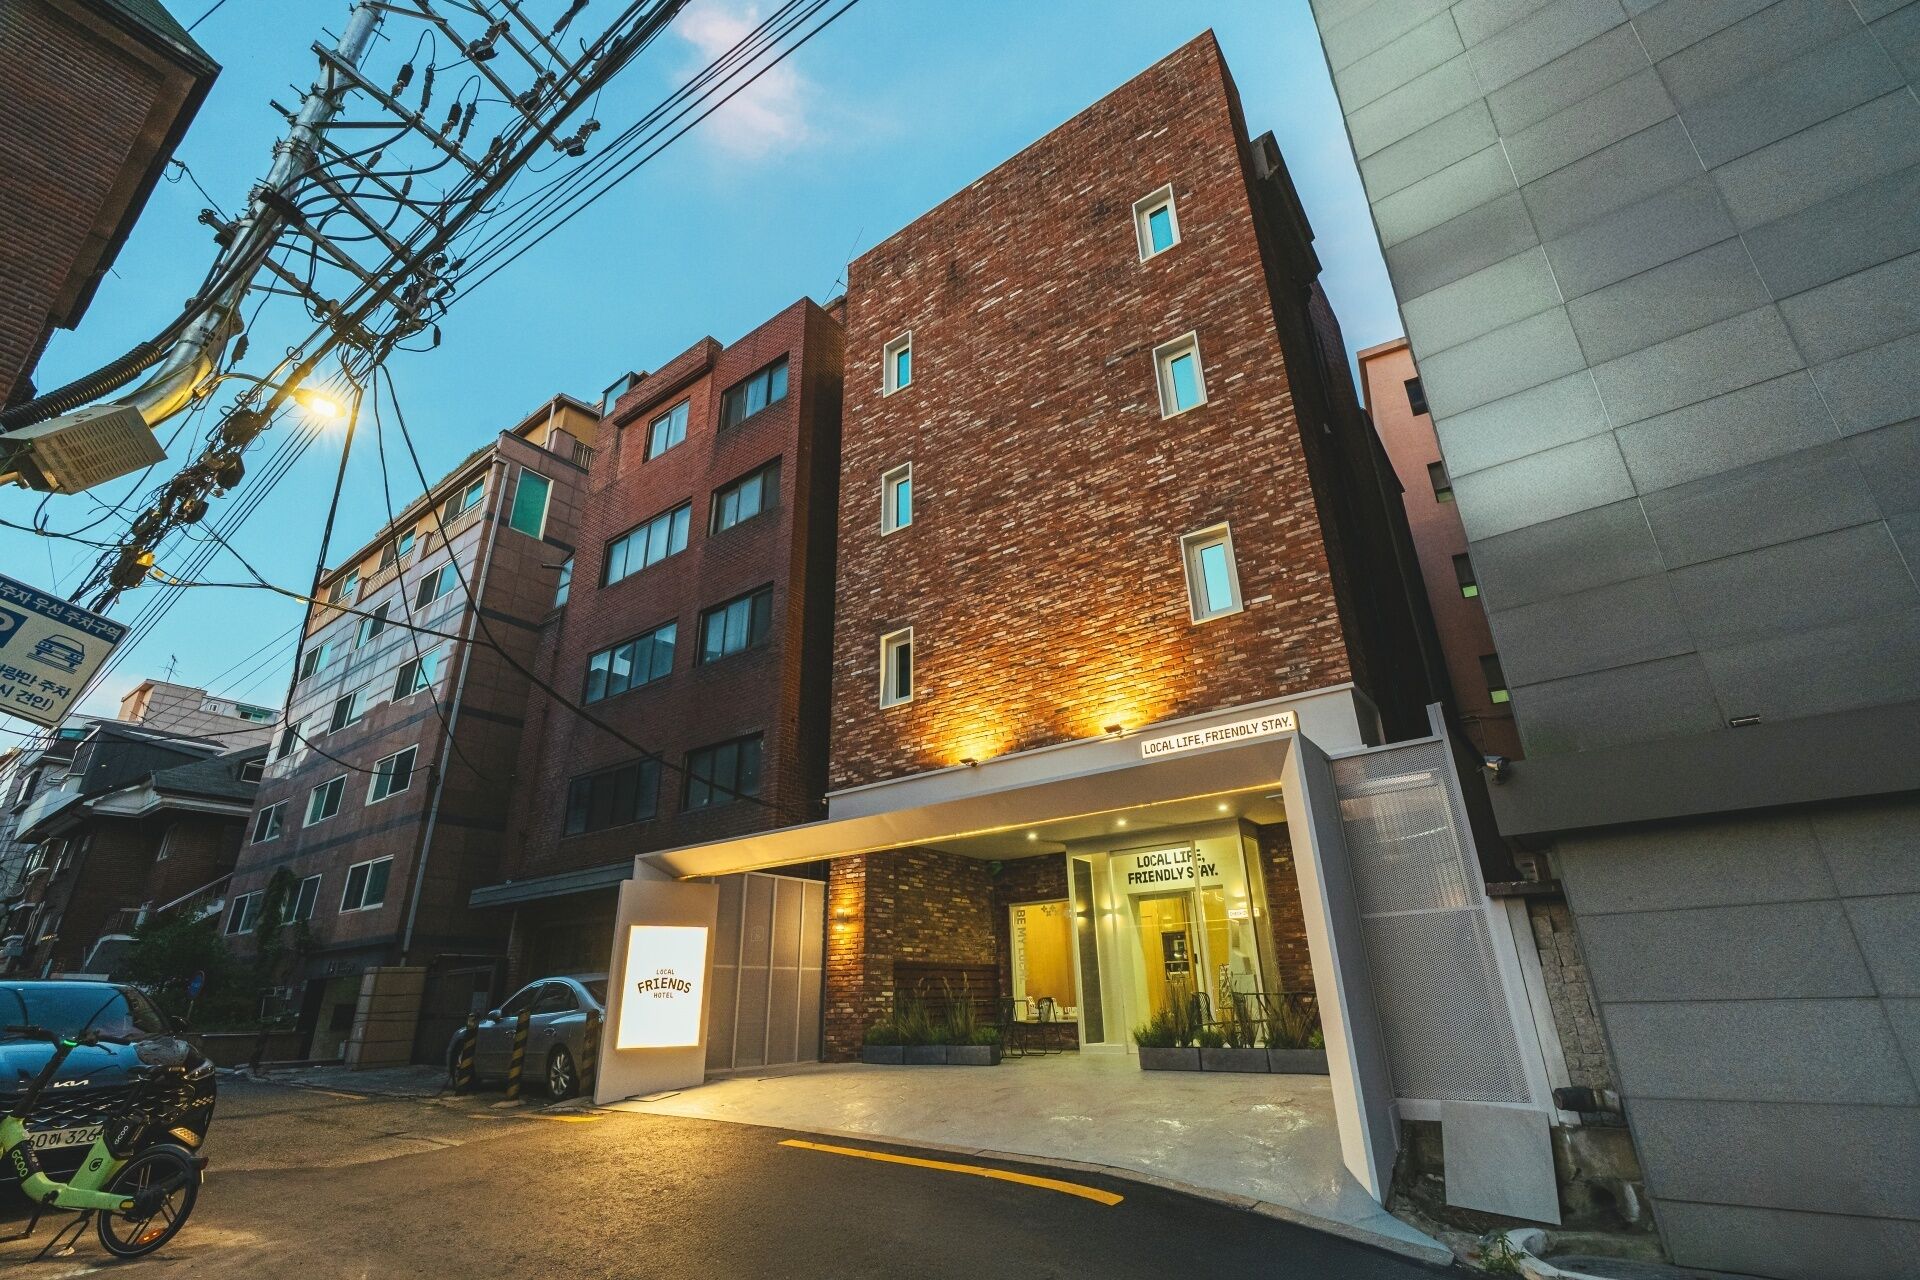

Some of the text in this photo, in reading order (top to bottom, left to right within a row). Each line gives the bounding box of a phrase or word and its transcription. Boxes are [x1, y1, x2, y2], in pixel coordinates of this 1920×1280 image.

[0, 581, 33, 605] 주자
[33, 597, 64, 618] 우선
[38, 679, 71, 699] 주차
[1144, 716, 1292, 755] LOCAL LIFE, FRIENDLY STAY.
[1136, 853, 1171, 868] LOCAL
[1128, 863, 1219, 885] FRIENDLY SAY.
[1017, 909, 1026, 925] BE
[1017, 927, 1027, 944] MY
[637, 978, 691, 994] FRIENDS
[65, 1127, 104, 1145] 326
[11, 1149, 29, 1177] GCOO
